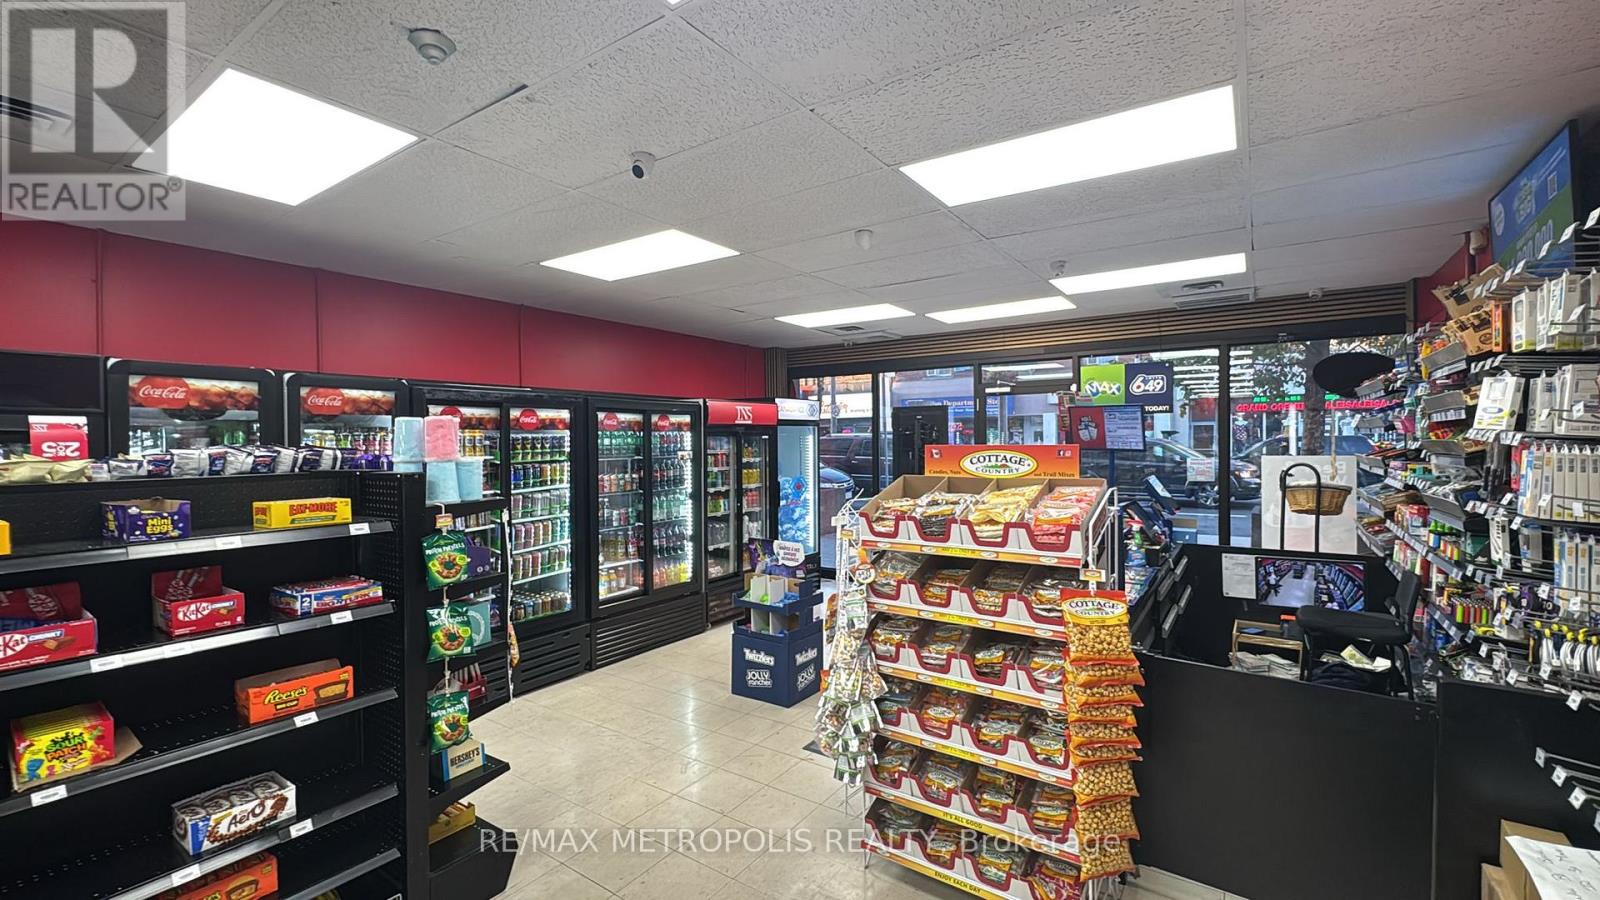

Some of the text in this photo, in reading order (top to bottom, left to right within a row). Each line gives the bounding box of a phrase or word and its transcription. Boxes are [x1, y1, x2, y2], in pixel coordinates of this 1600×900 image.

[969, 455, 1026, 466] COTTAGE
[289, 502, 338, 516] EAT-MORE
[147, 517, 172, 526] Mini
[146, 525, 174, 534] Eggs
[302, 598, 310, 606] 2
[1069, 601, 1119, 610] COTTAGE
[747, 671, 770, 680] JOLLY
[46, 736, 84, 752] SOUR
[450, 747, 480, 767] HERSHEY'S
[228, 802, 265, 832] Aero
[968, 818, 983, 828] GOOD
[935, 871, 981, 893] ENJOY EACH DAY
